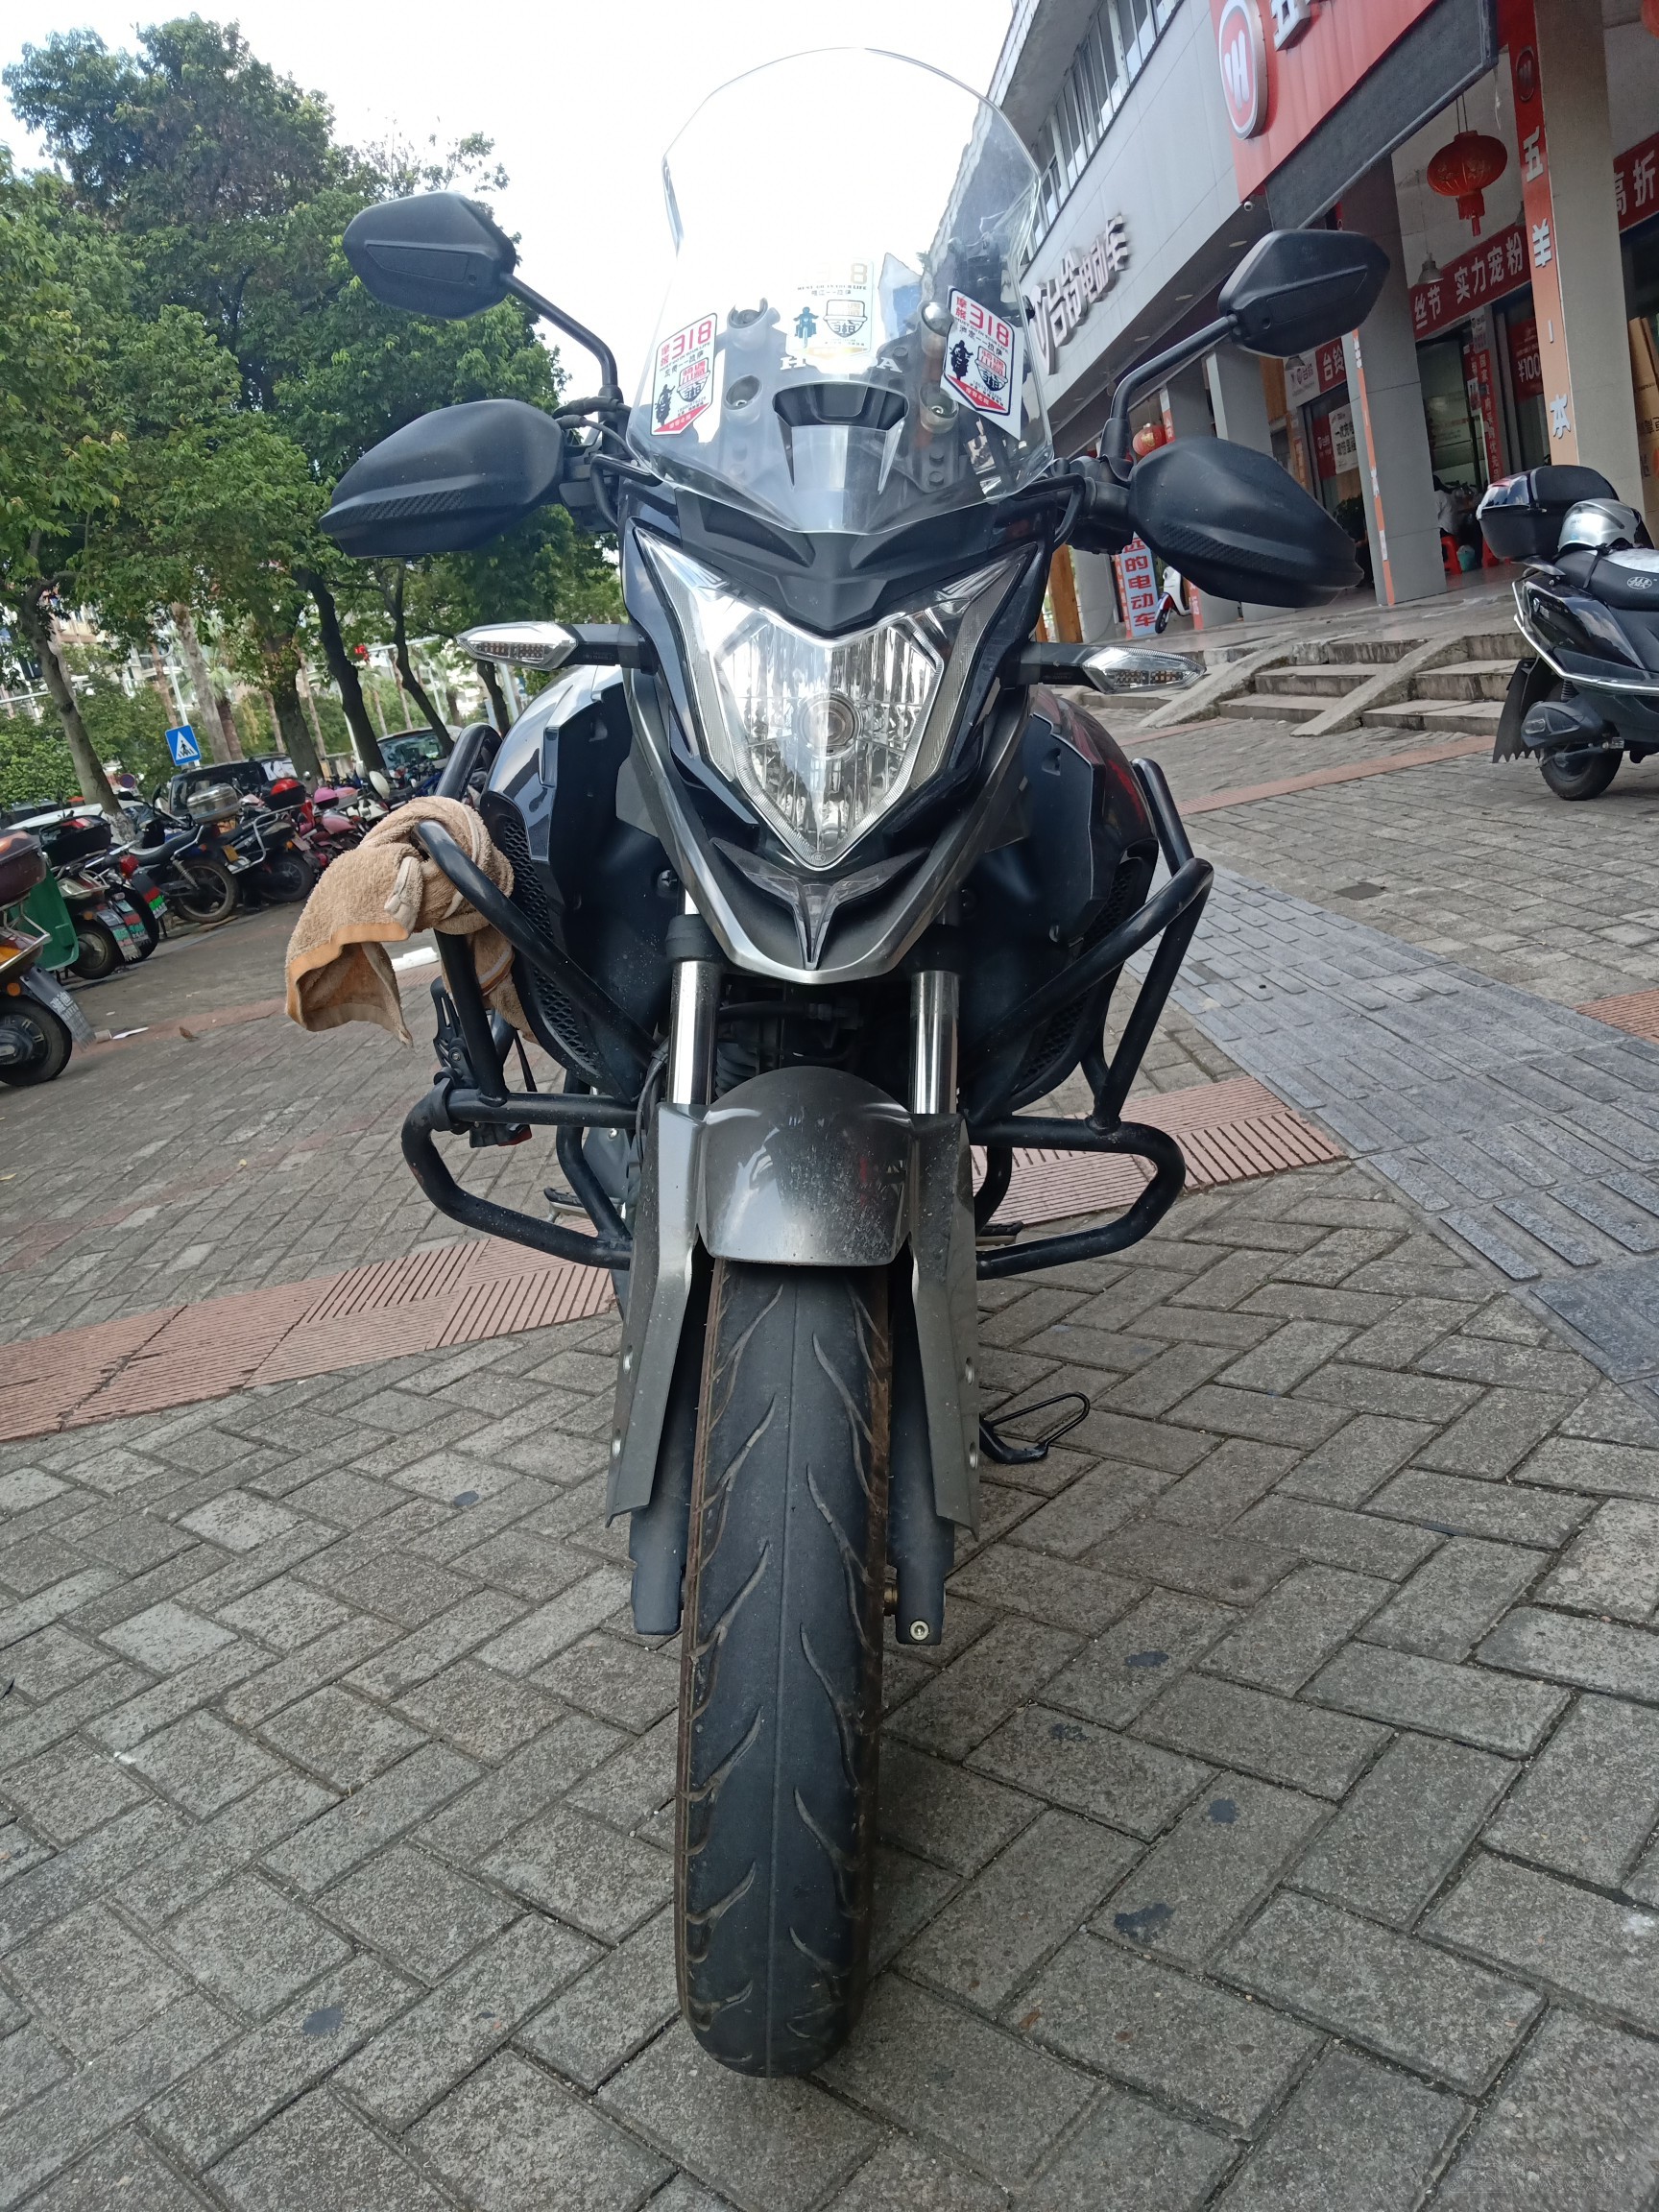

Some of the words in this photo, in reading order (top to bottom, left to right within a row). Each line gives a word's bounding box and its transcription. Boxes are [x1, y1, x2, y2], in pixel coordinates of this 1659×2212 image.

[1454, 231, 1524, 304] 实力宠粉
[672, 320, 712, 360] 318
[970, 303, 1009, 347] 318
